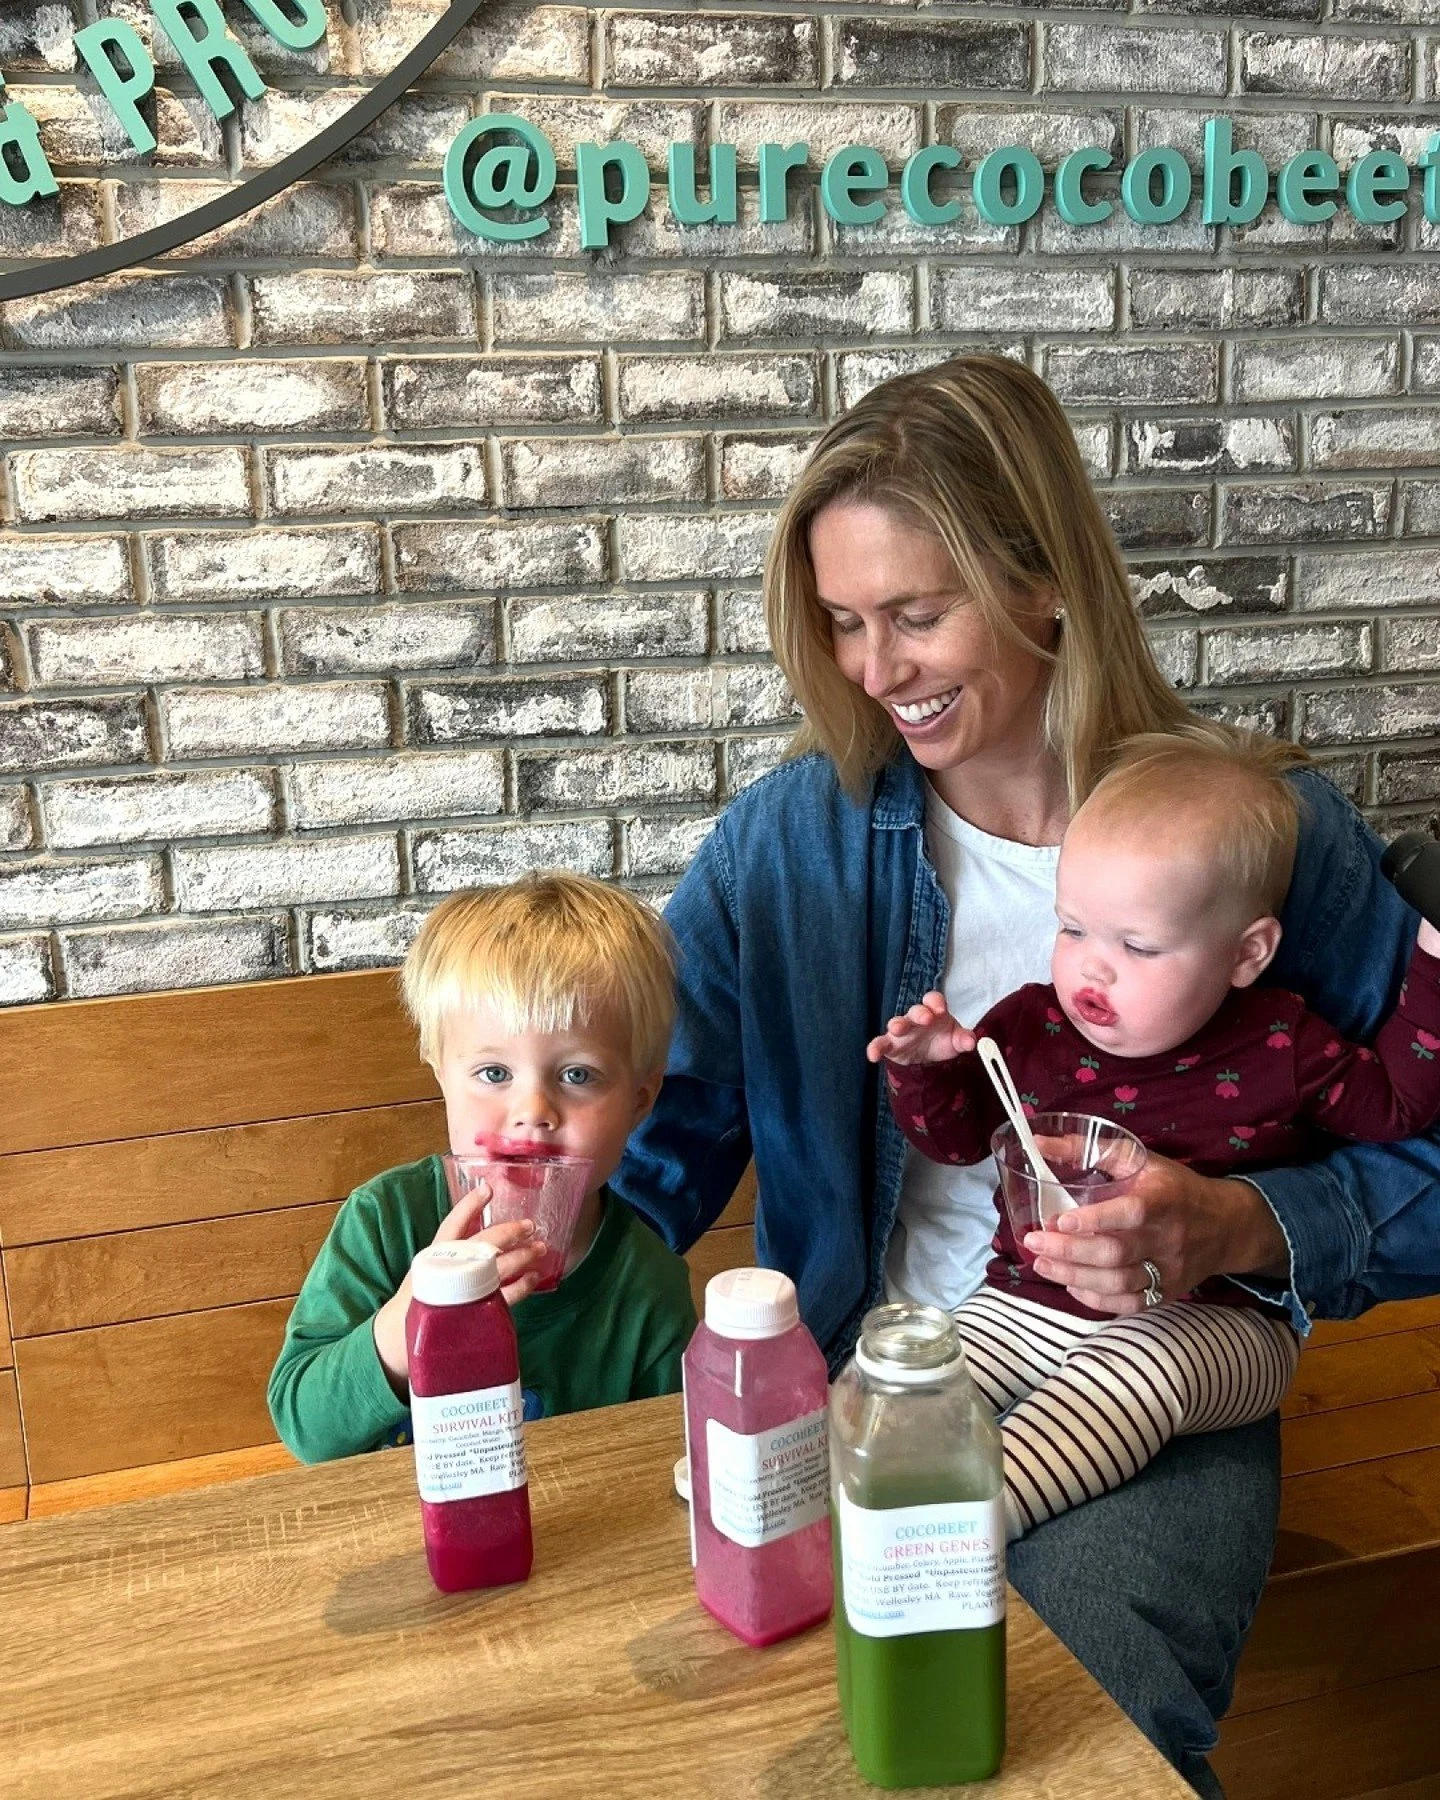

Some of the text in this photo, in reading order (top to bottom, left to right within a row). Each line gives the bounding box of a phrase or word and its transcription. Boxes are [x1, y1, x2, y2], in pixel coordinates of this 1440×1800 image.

[441, 1397, 509, 1418] COCOBEET
[432, 1415, 495, 1434] SURVIVAL
[498, 1409, 519, 1424] KIT
[770, 1421, 826, 1451] COCOBEET
[761, 1441, 815, 1471] SURVIVAL
[818, 1433, 828, 1449] KI
[895, 1520, 978, 1541] COCOBEET
[883, 1538, 991, 1561] GREEN GENES
